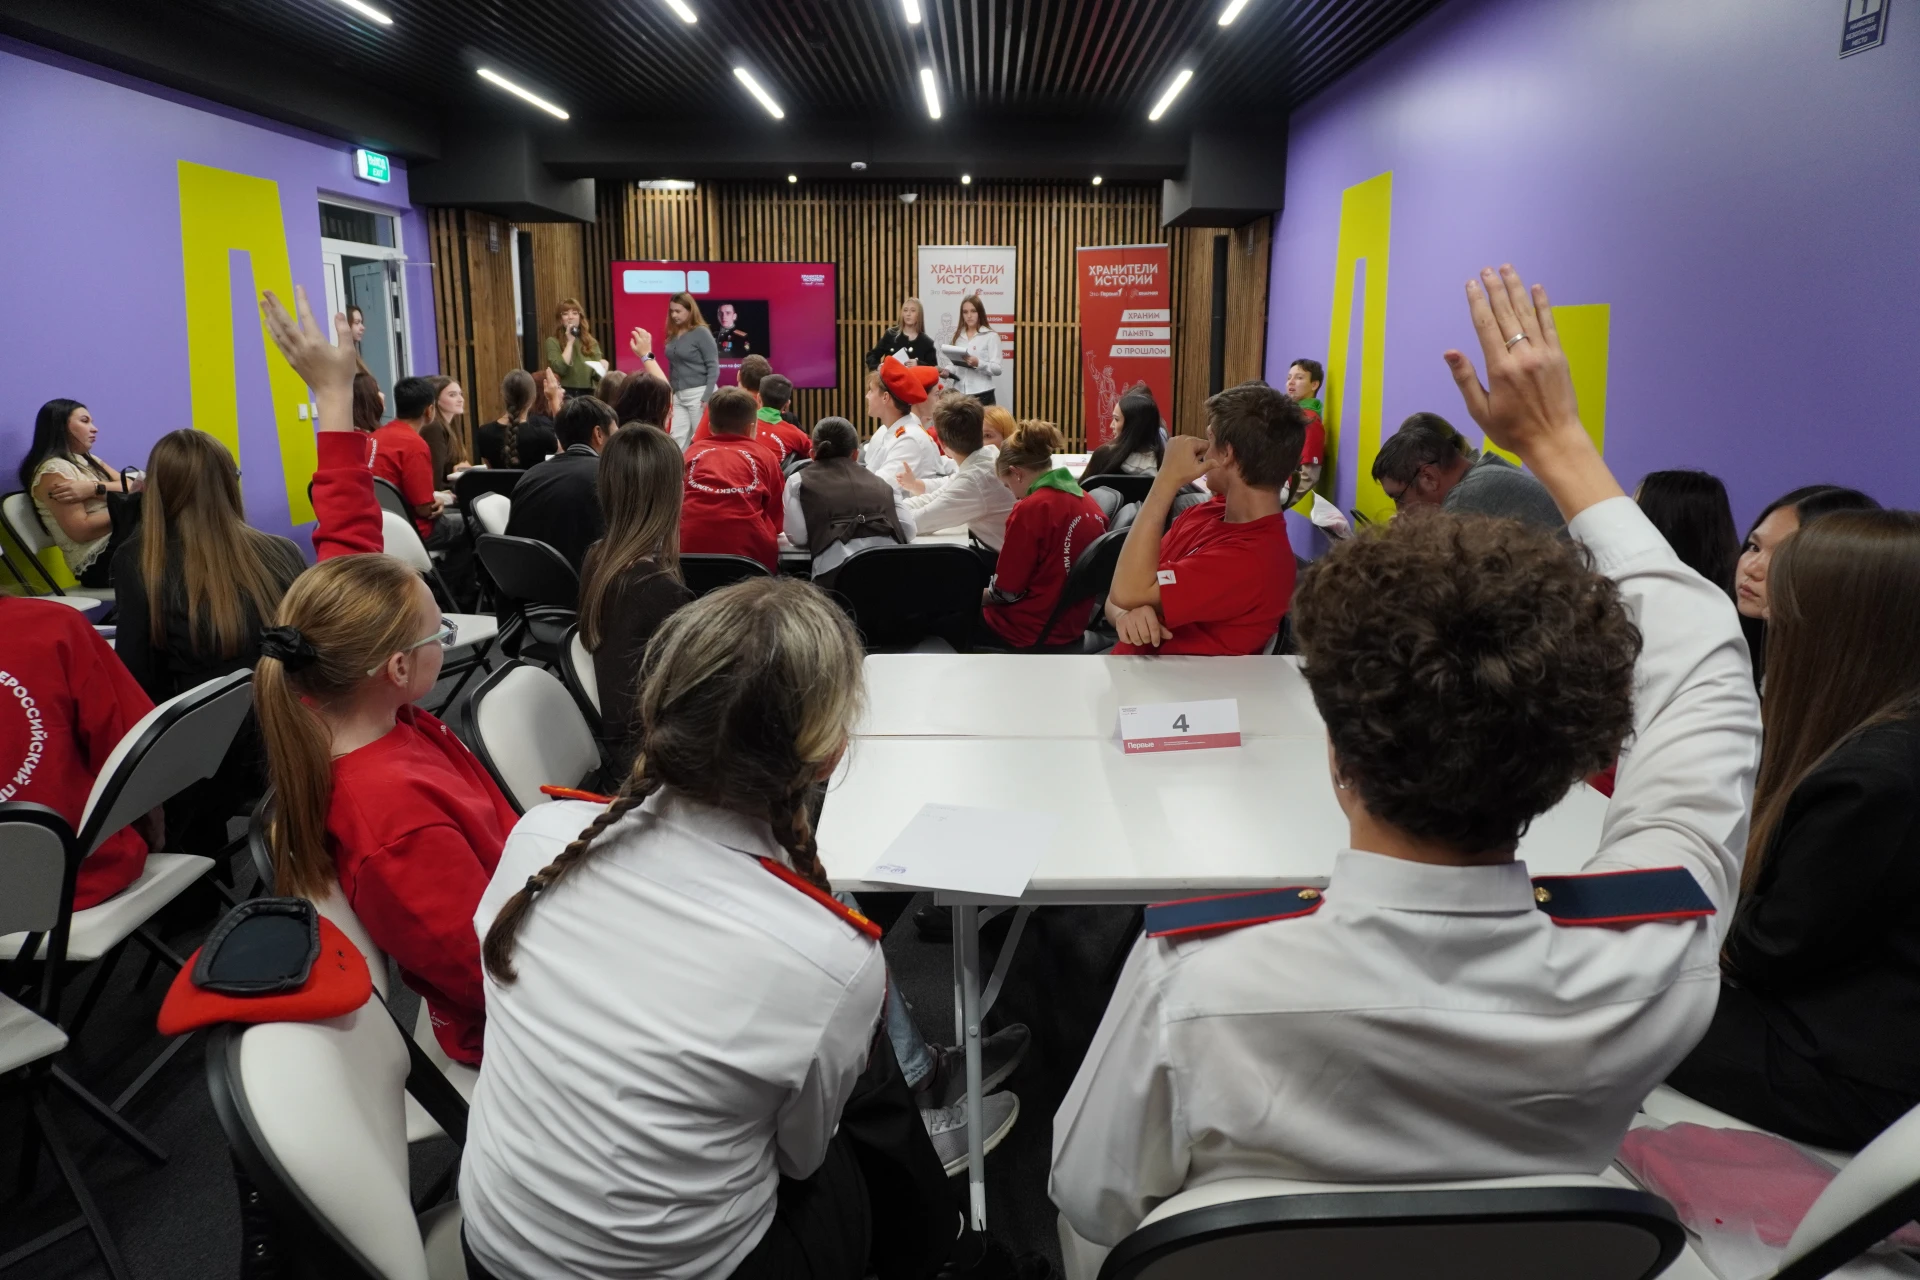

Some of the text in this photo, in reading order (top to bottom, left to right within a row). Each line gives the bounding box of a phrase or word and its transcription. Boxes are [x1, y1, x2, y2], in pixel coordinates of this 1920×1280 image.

[930, 264, 1005, 275] ХРАНИТЕЛИ
[1088, 263, 1159, 276] ХРАНИТЕЛИ
[936, 274, 998, 285] ИСТОРИИ
[1094, 274, 1153, 286] ИСТОРИИ
[1128, 312, 1161, 320] ХРАНИМ
[1122, 329, 1154, 337] ПАМЯТЬ
[1116, 347, 1167, 355] О ПРОШЛОМ
[0, 670, 49, 786] ЕРОССИЙСКИЙ
[1172, 713, 1190, 733] 4
[1127, 741, 1155, 751] Первые
